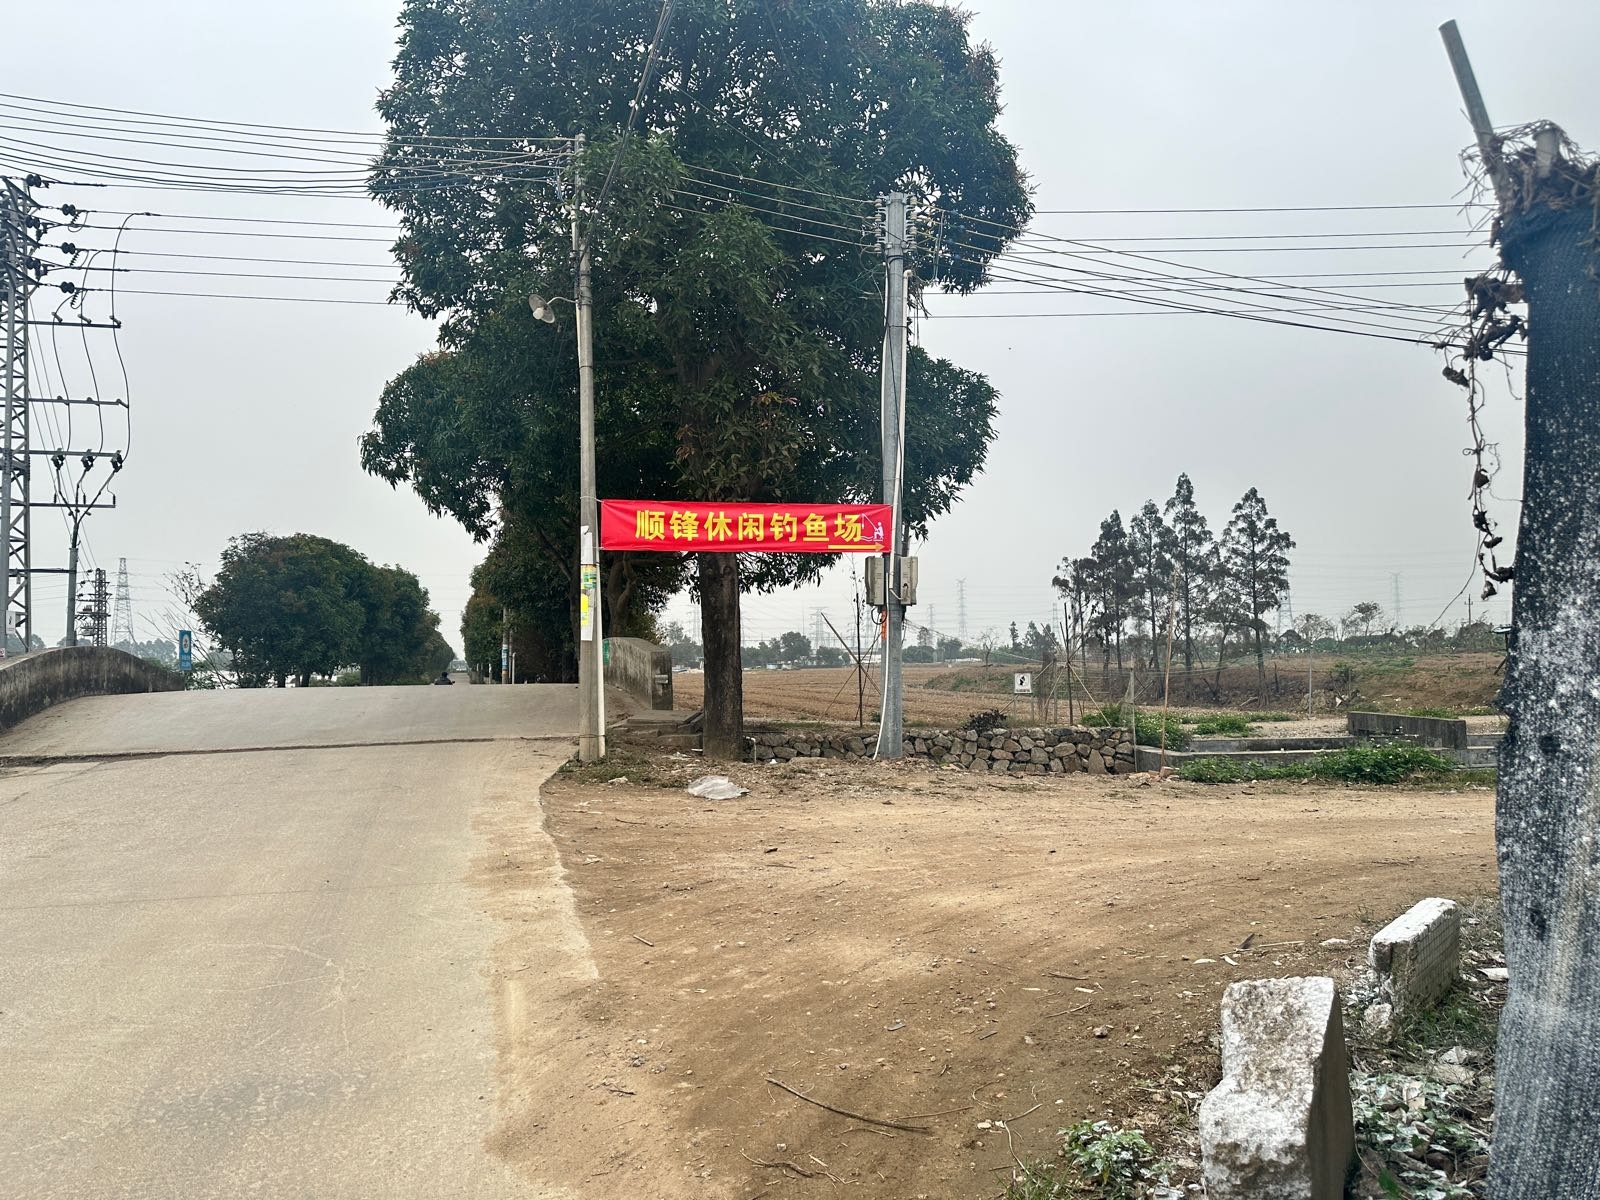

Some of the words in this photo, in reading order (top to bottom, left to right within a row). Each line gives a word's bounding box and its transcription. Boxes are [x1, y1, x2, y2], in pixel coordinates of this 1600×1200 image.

[635, 509, 862, 542] 顺锋休闲钓鱼场
